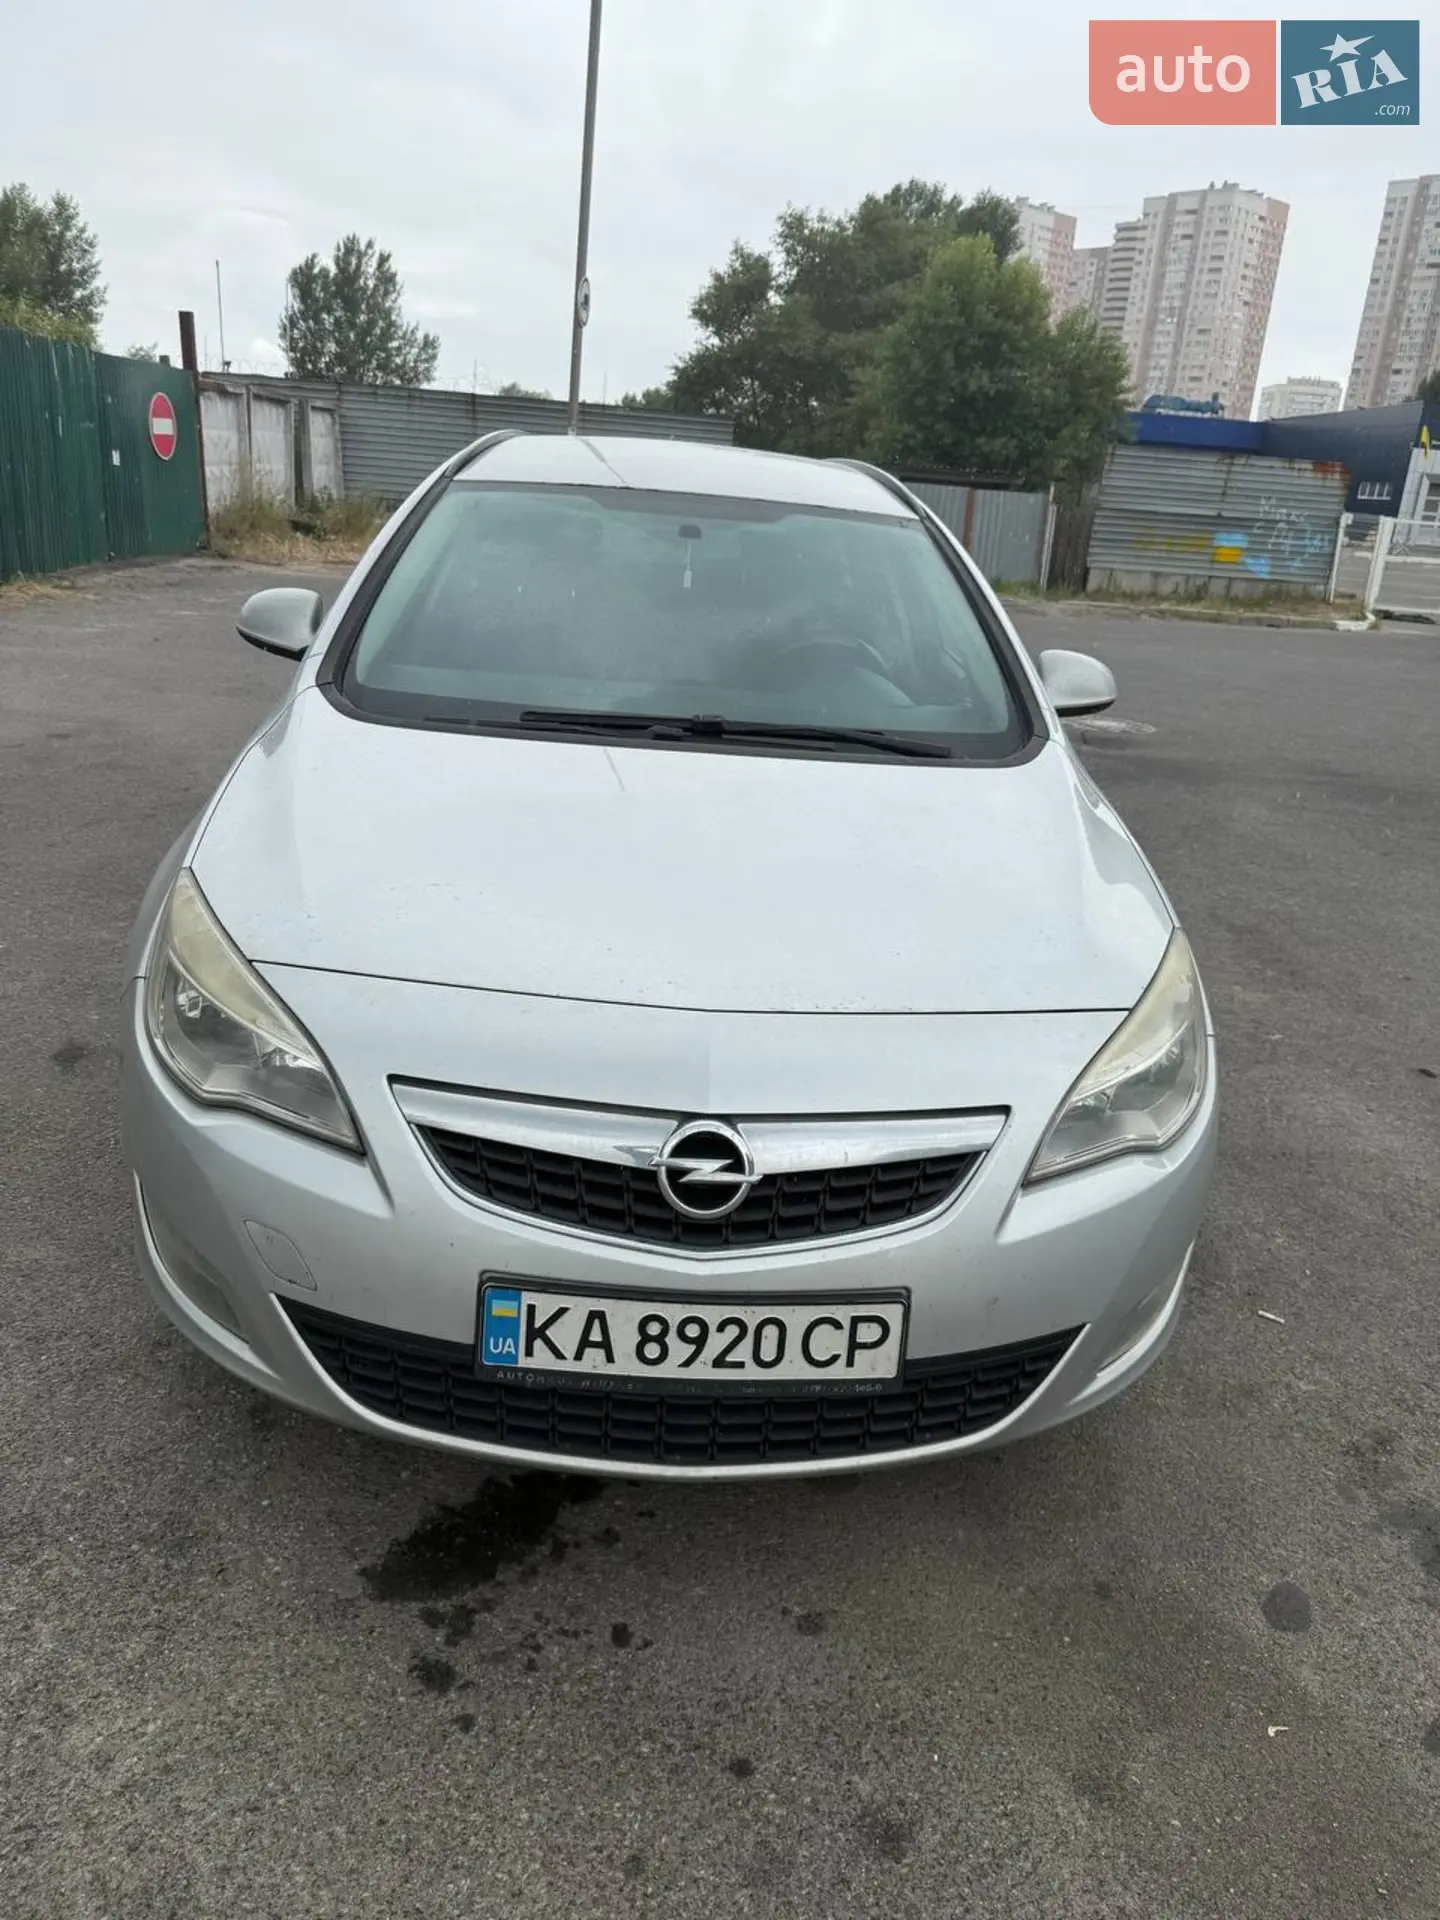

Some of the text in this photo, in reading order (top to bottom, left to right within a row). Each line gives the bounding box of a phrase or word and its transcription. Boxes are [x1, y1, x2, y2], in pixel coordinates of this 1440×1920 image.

[489, 1336, 516, 1355] UA
[525, 1303, 890, 1370] KA 8920 CP
